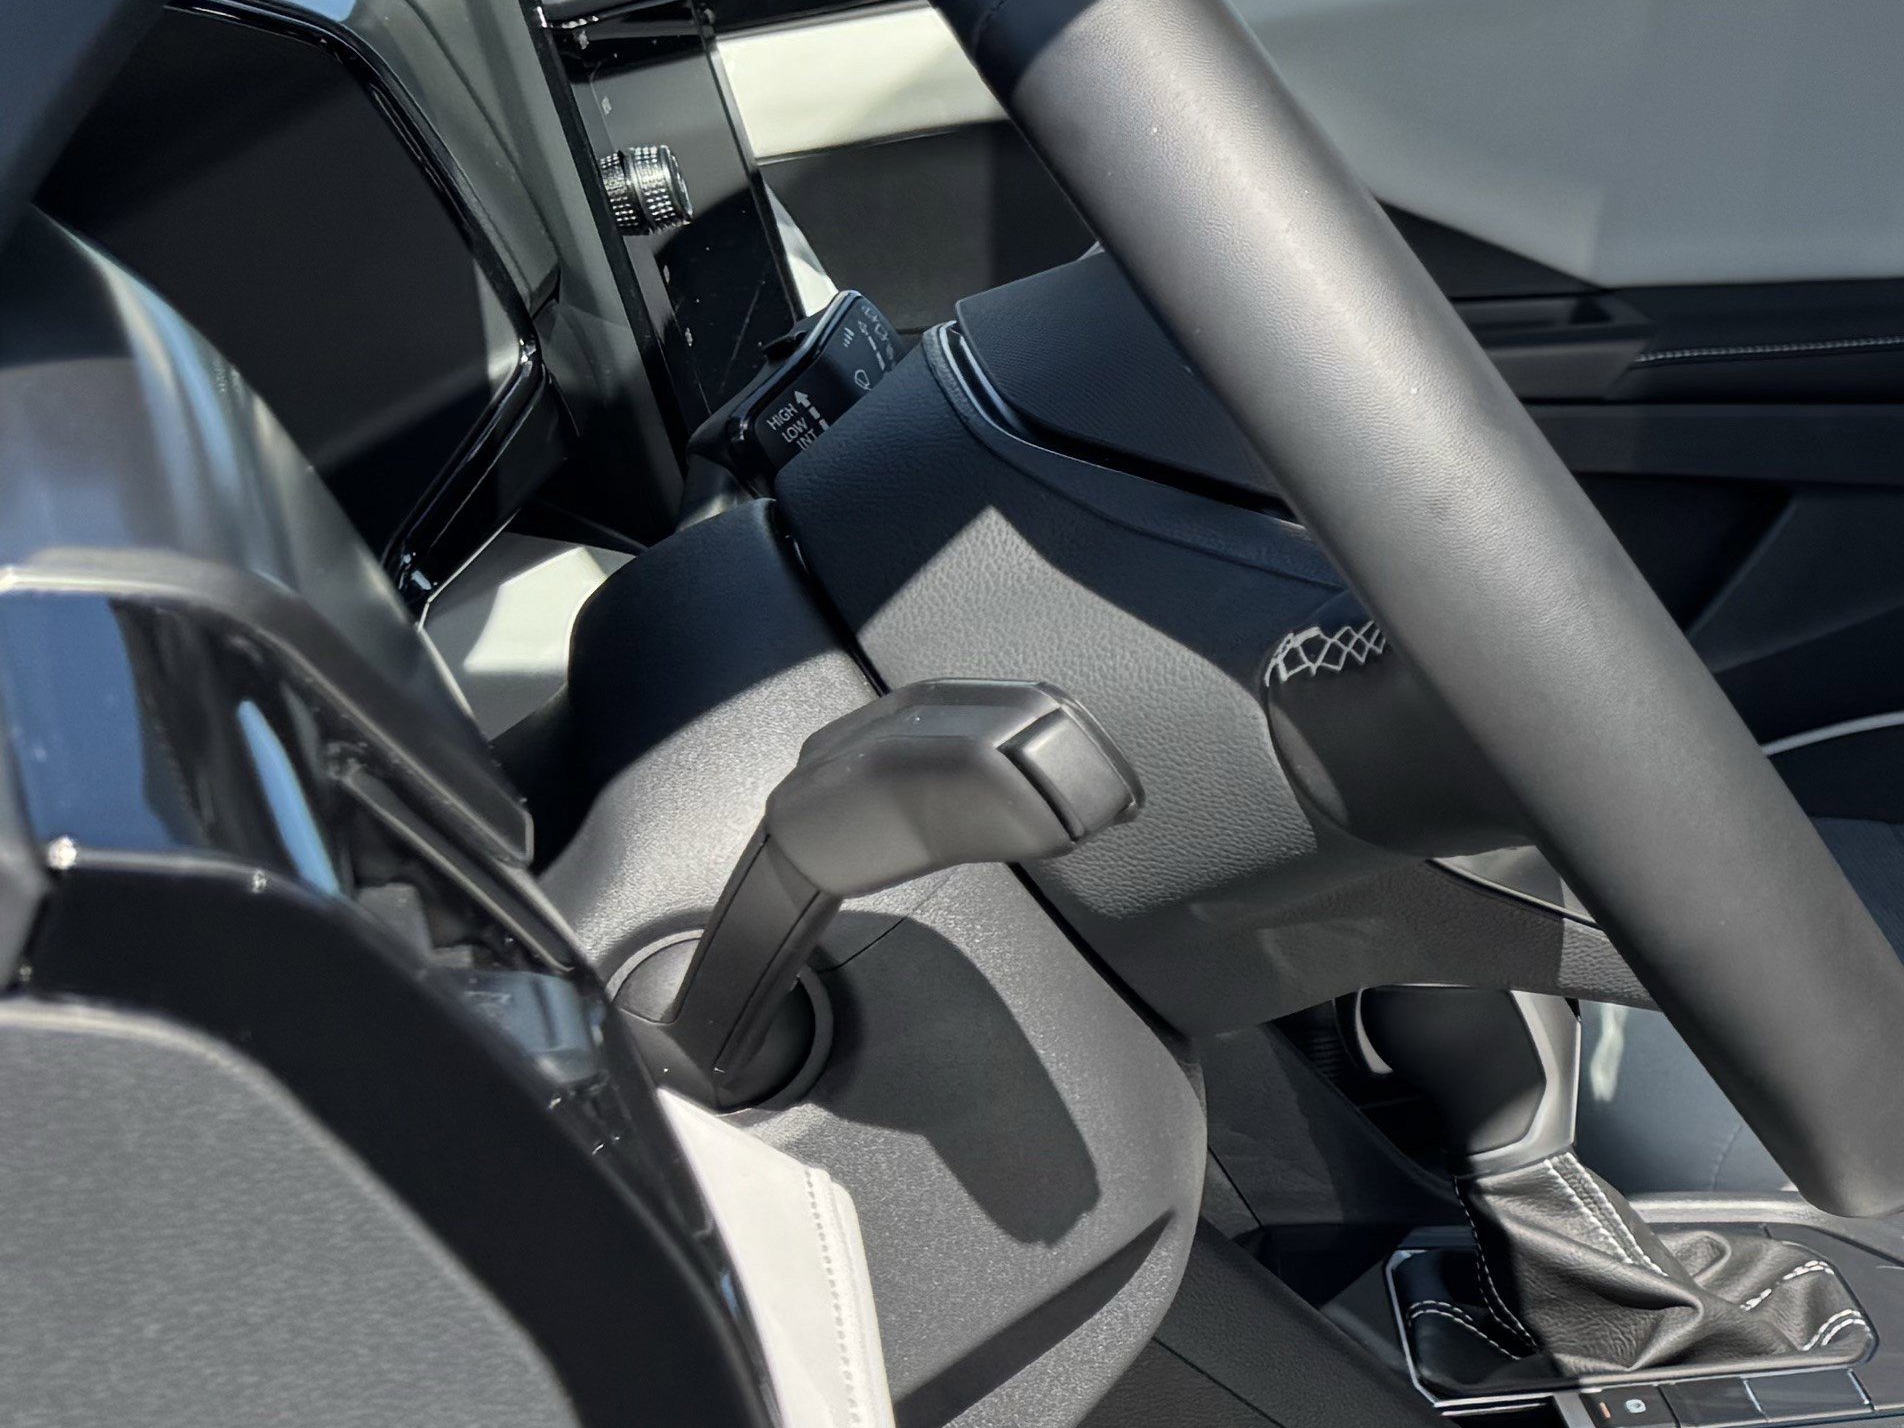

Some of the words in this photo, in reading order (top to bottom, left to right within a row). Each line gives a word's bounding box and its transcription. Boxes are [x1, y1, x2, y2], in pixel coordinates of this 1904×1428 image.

[767, 403, 798, 430] HIGH
[781, 417, 809, 443] LOW
[796, 430, 817, 451] INT
